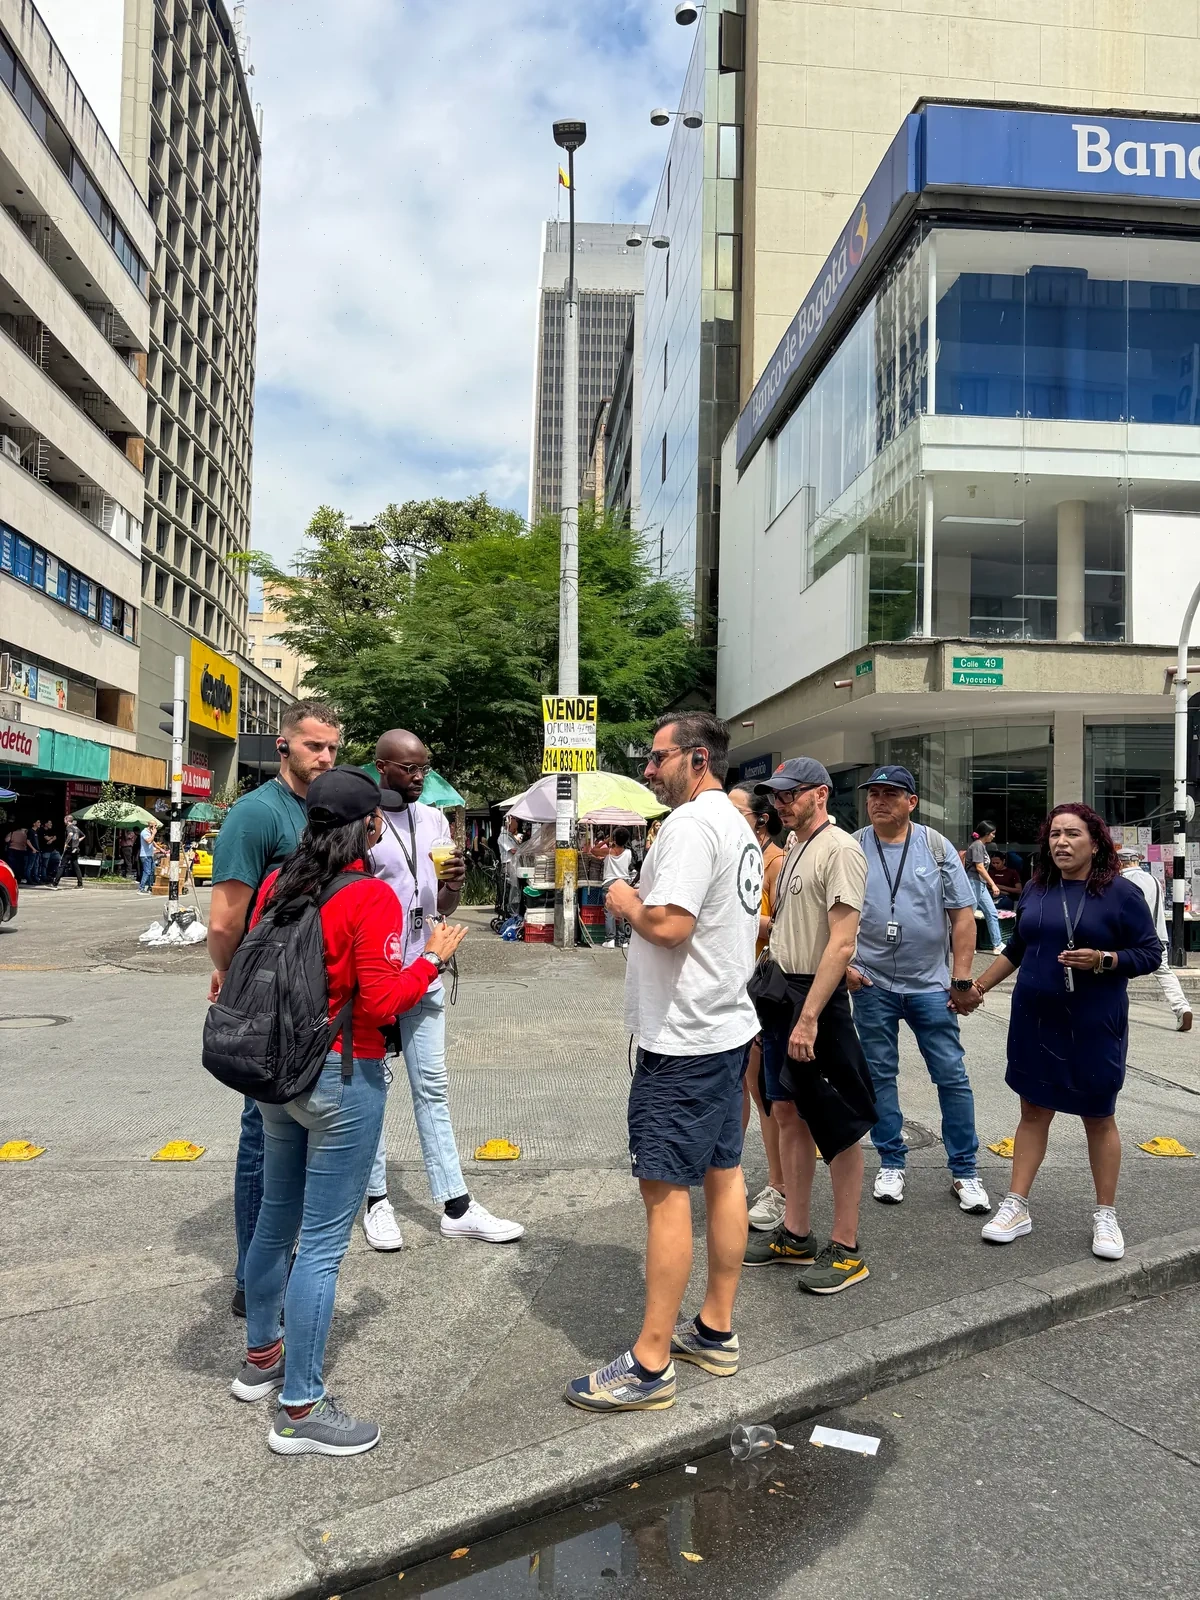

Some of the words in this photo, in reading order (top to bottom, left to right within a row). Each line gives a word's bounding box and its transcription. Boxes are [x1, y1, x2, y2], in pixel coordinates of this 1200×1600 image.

[751, 357, 783, 428] Banco
[782, 330, 798, 375] de
[797, 238, 848, 349] Bogotá
[960, 658, 979, 668] Calle
[984, 658, 996, 668] 49
[959, 673, 997, 685] Ayacucho
[545, 697, 595, 721] VENDE
[0, 725, 33, 756] detta
[543, 749, 558, 771] 314
[559, 749, 573, 772] 833
[574, 750, 584, 772] 71
[585, 750, 595, 772] 82
[187, 771, 193, 787] A
